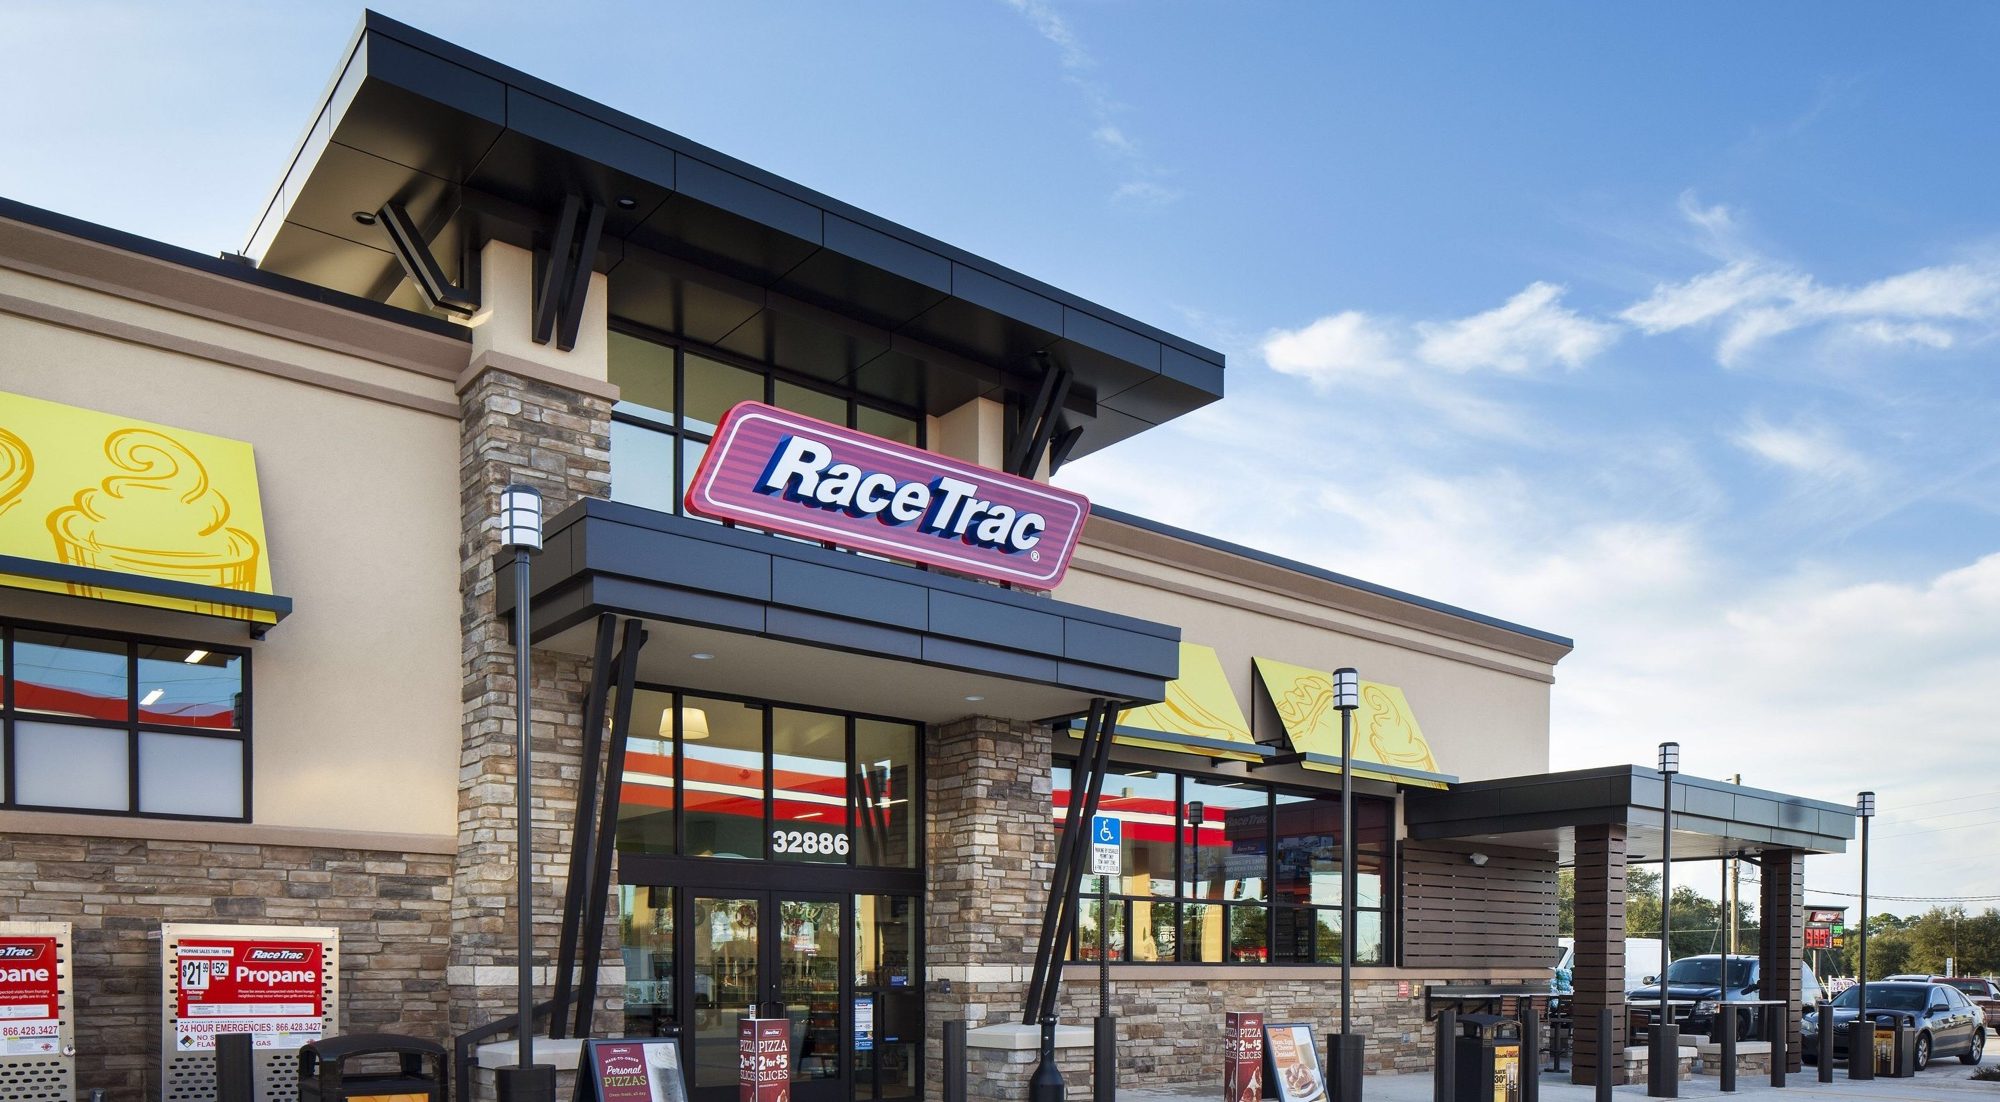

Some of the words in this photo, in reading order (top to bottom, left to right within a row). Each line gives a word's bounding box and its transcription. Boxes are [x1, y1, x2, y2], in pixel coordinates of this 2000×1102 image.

[763, 434, 1046, 551] RaceTrac
[772, 830, 850, 855] 32886
[252, 950, 303, 959] RaceTrac
[236, 966, 315, 986] Propane
[3, 1026, 57, 1036] 866.428.3427
[216, 1023, 274, 1032] EMERGENCIES:
[276, 1023, 321, 1032] 866.428.3427
[1240, 1028, 1262, 1038] PIZZA
[740, 1040, 756, 1052] PIZZA
[759, 1040, 787, 1052] PIZZA
[1240, 1040, 1245, 1051] 2
[1252, 1040, 1262, 1051] $5
[1240, 1051, 1262, 1060] SLICES
[740, 1055, 745, 1069] 2
[759, 1056, 765, 1070] 2
[766, 1059, 775, 1067] for
[776, 1055, 787, 1069] $5
[607, 1064, 642, 1075] Personal
[603, 1075, 647, 1087] PIZZAS
[740, 1070, 756, 1081] SLICES
[759, 1070, 788, 1081] SLICES
